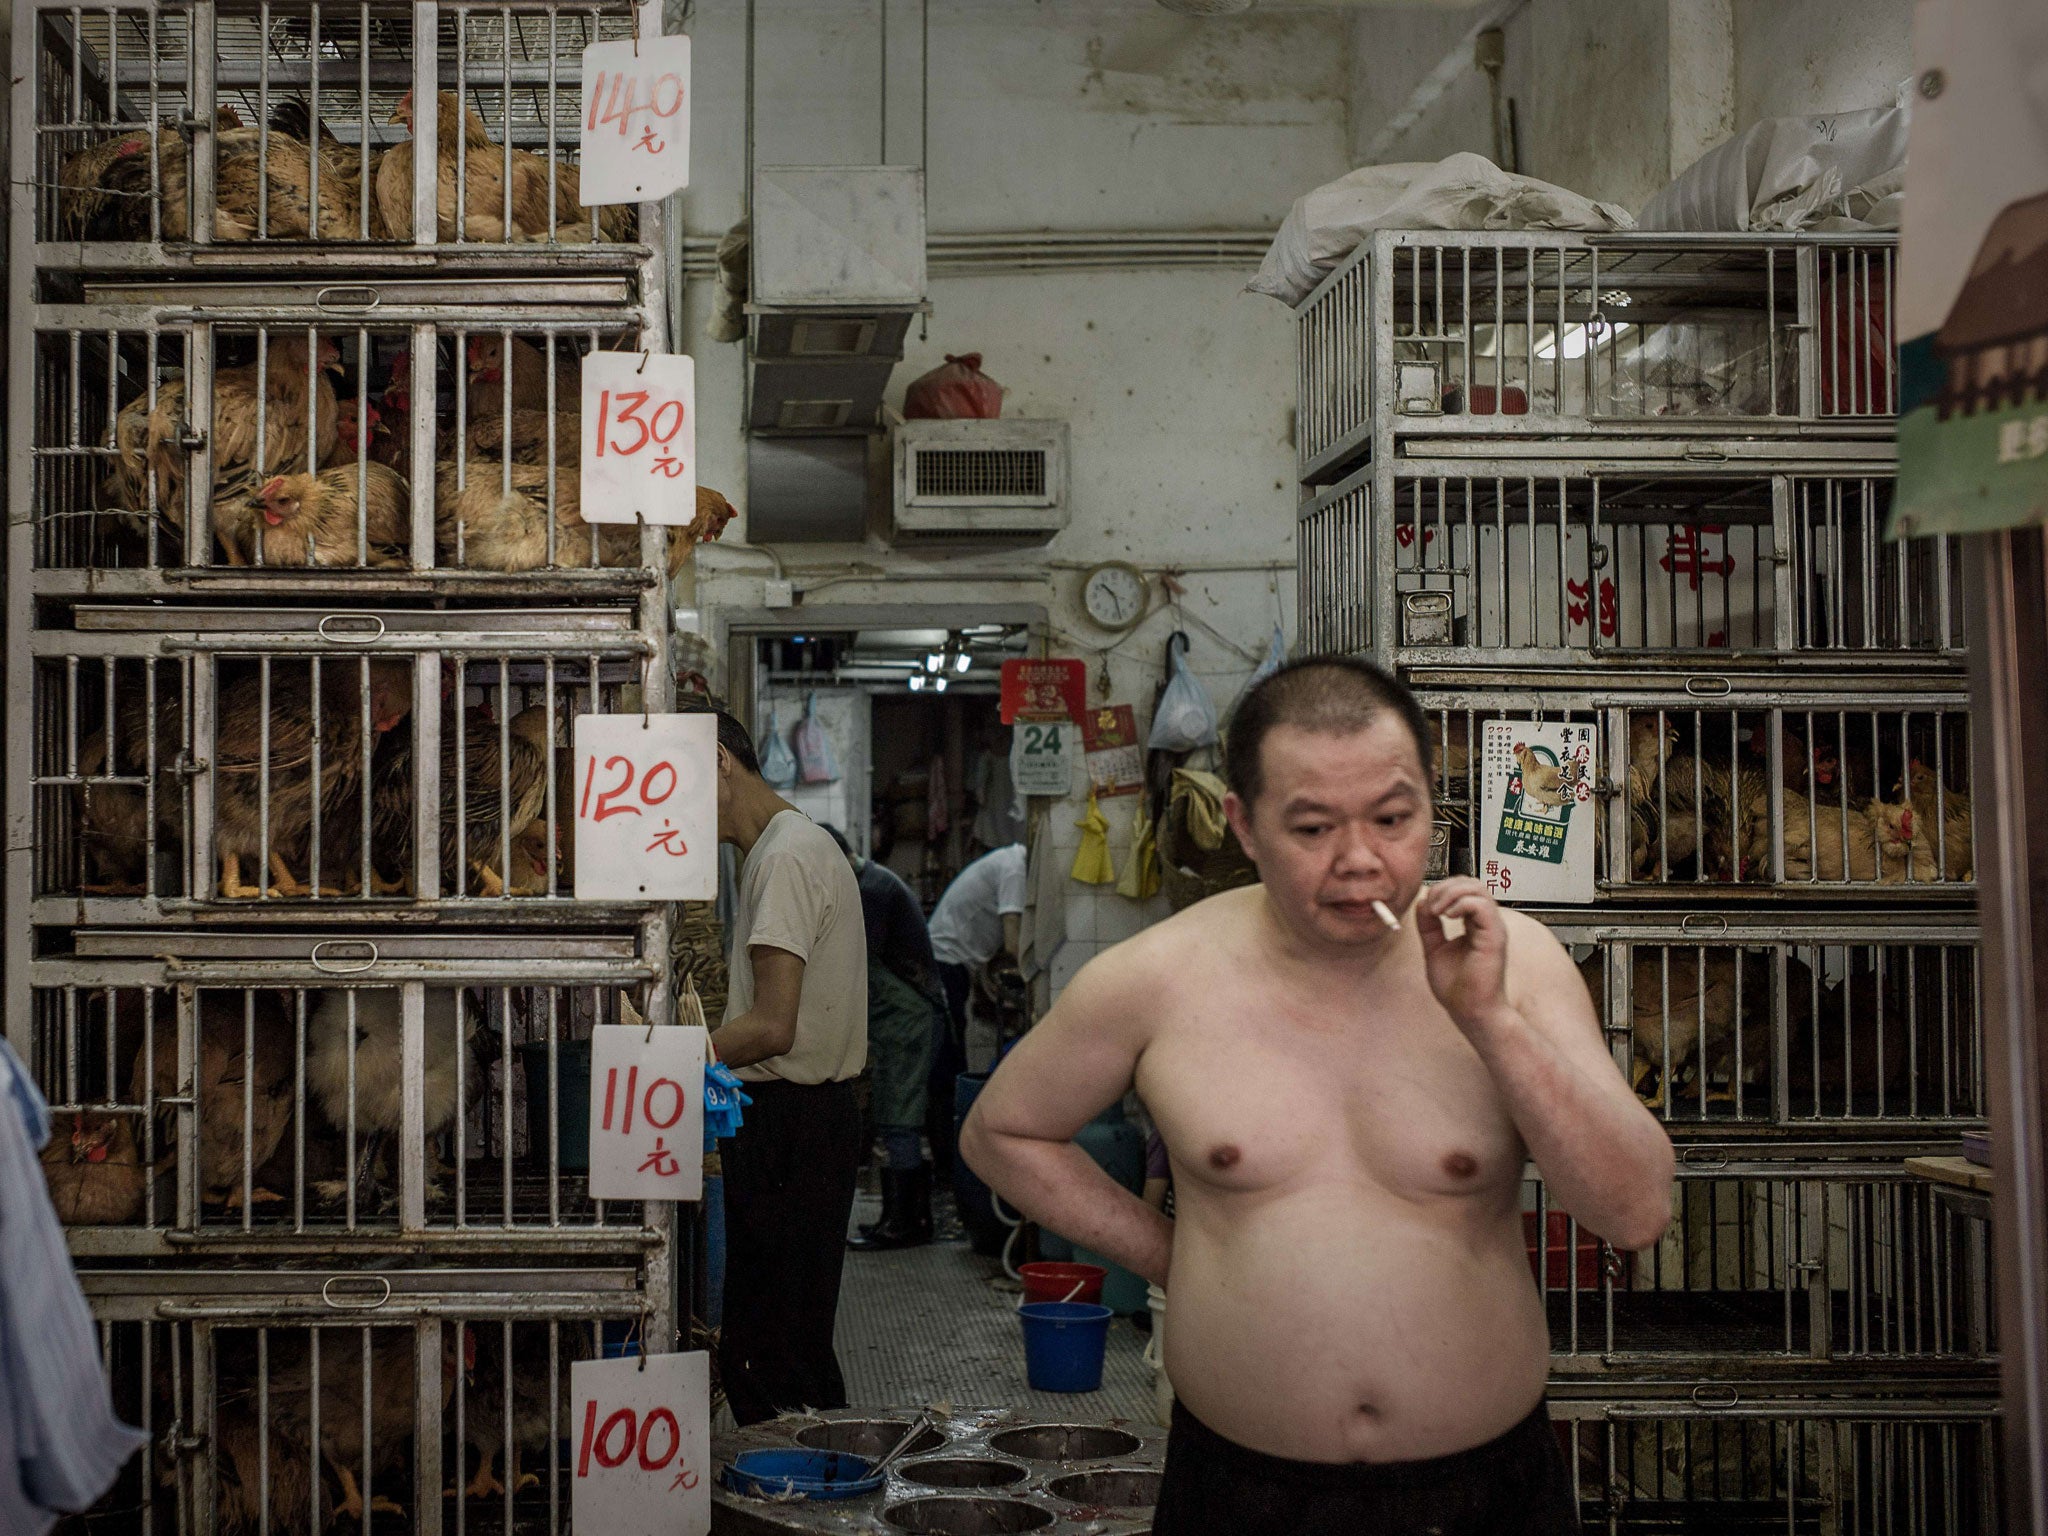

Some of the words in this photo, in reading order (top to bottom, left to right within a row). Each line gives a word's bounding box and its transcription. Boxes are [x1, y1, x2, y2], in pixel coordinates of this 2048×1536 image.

[587, 70, 685, 136] 140
[631, 125, 665, 155] 元
[595, 389, 684, 459] 130
[650, 445, 684, 479] 元
[1024, 725, 1062, 755] 24
[1556, 726, 1574, 800] 豐衣足食
[579, 754, 678, 824] 120
[645, 818, 688, 857] 元
[1499, 865, 1512, 894] $
[601, 1064, 686, 1136] 110
[636, 1137, 681, 1178] 元
[576, 1398, 681, 1479] 100
[668, 1457, 700, 1493] 元
